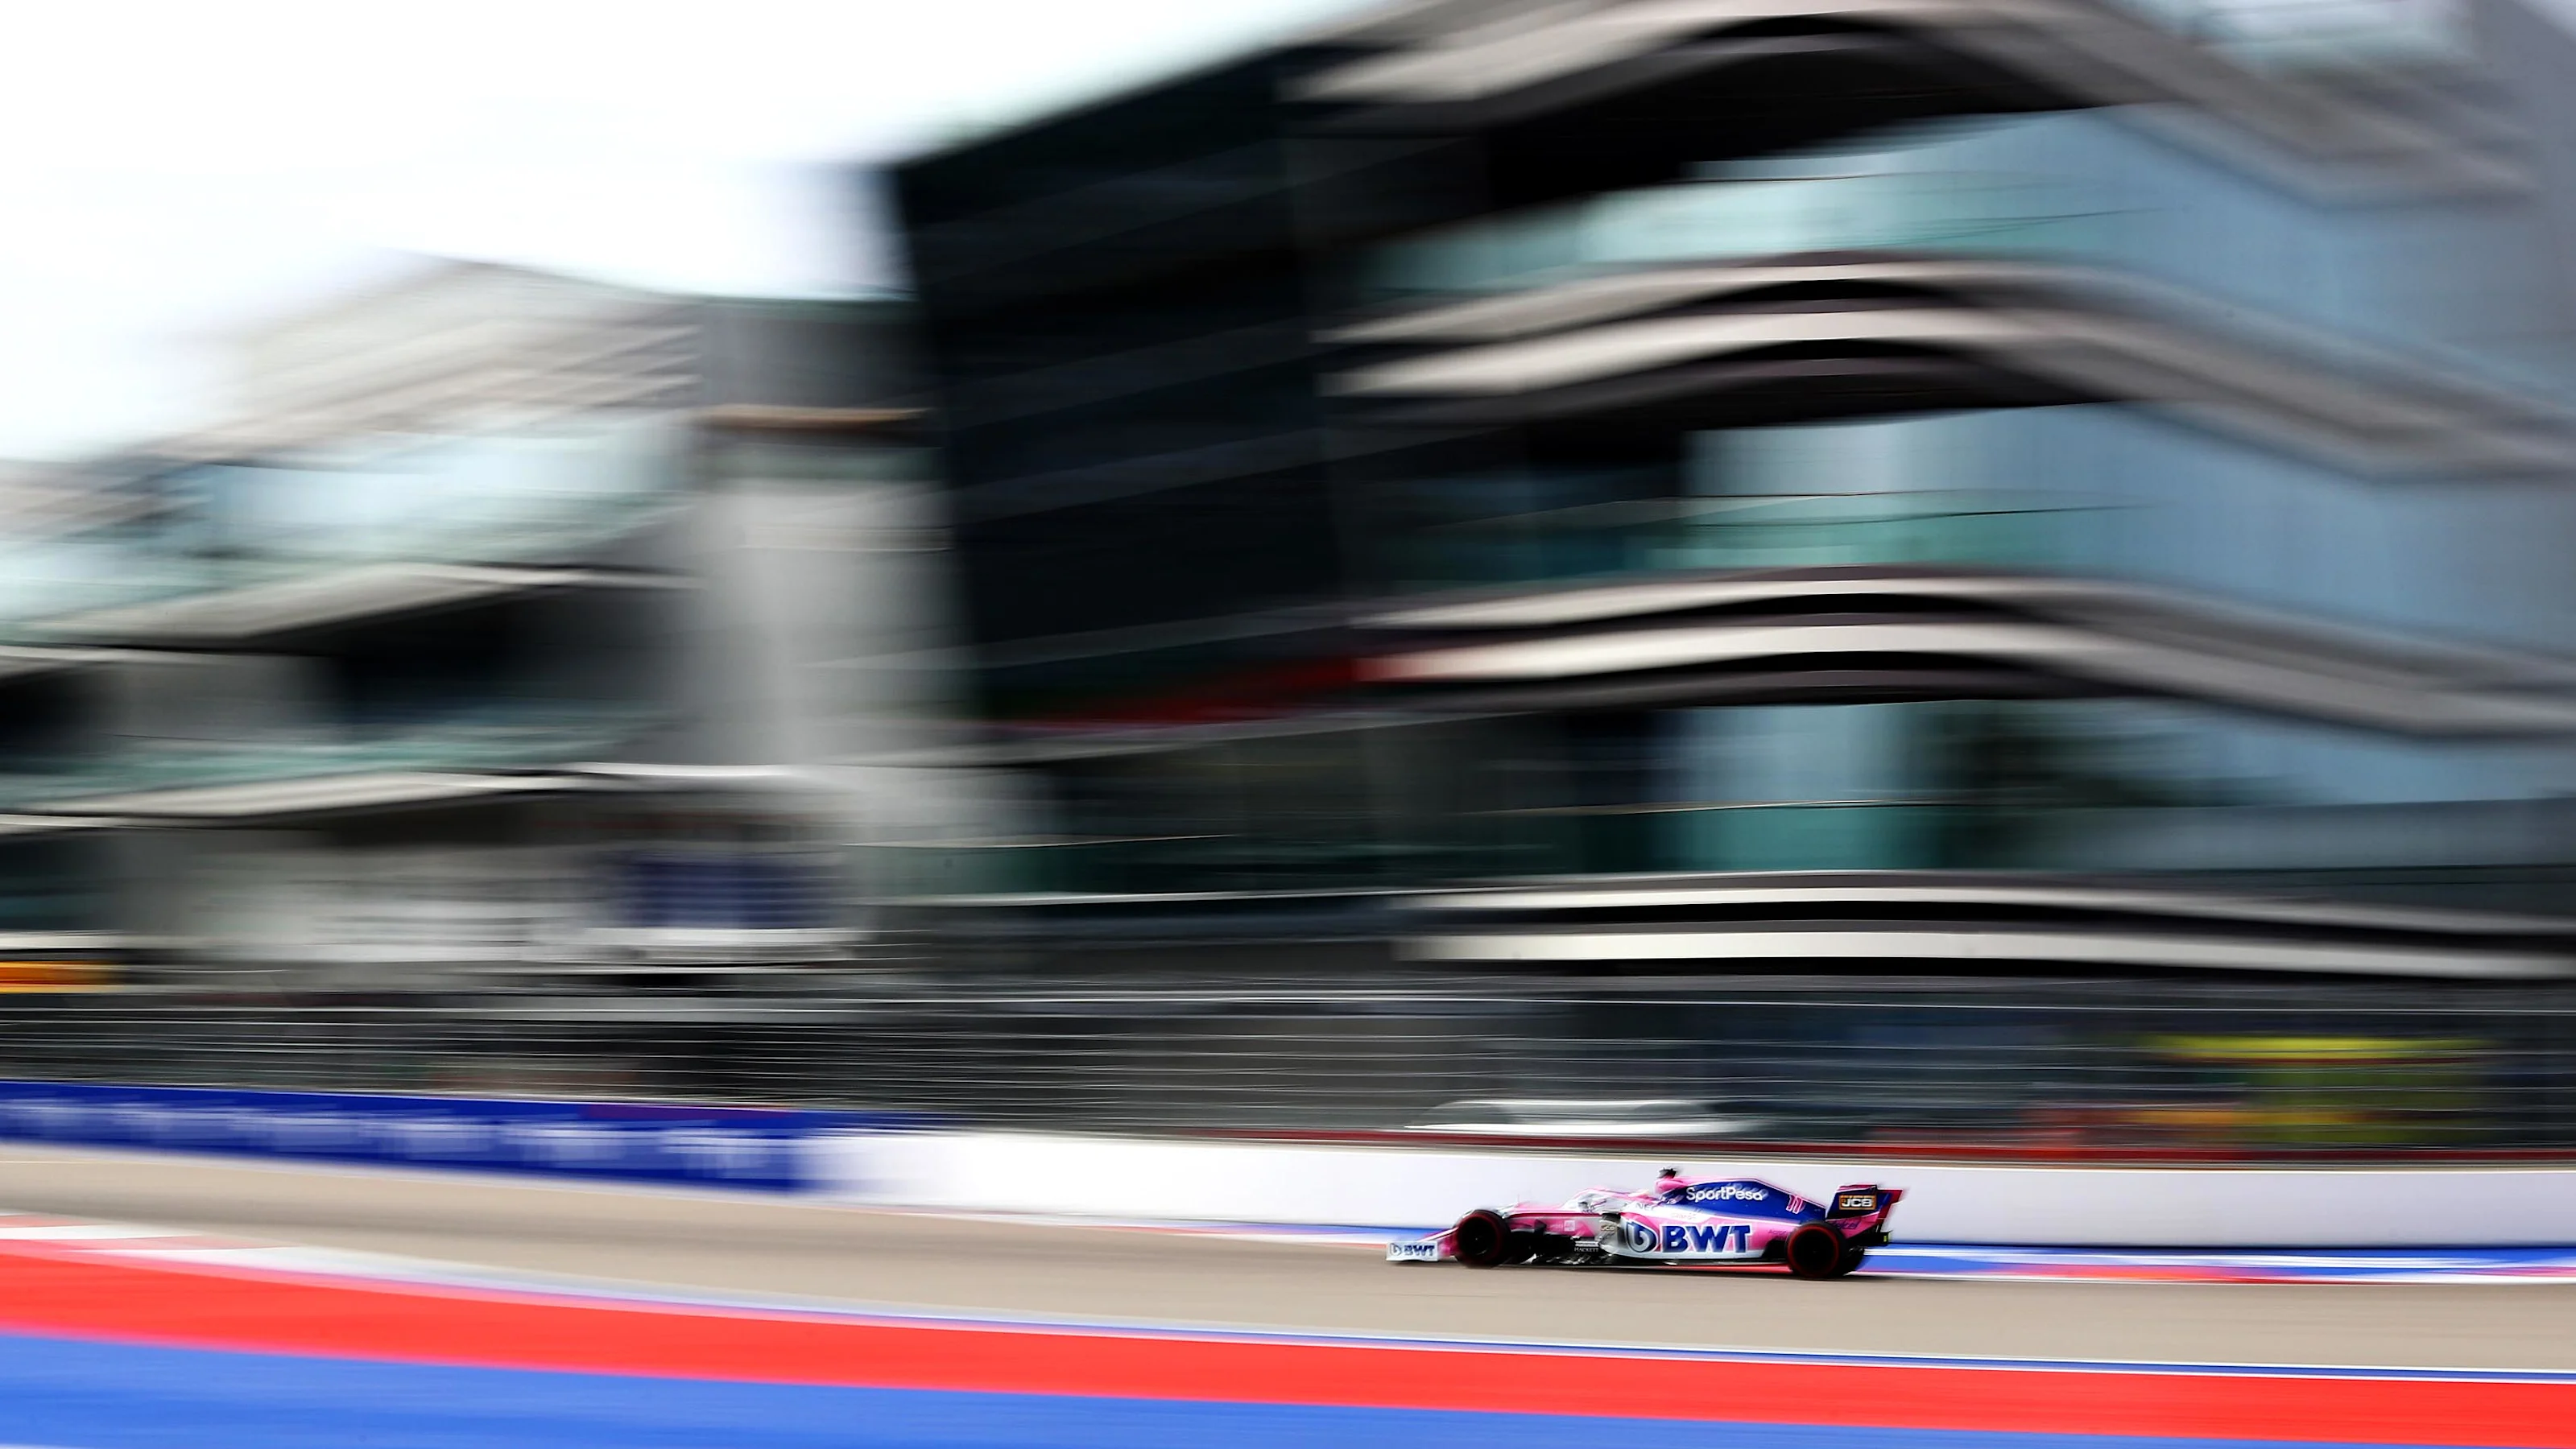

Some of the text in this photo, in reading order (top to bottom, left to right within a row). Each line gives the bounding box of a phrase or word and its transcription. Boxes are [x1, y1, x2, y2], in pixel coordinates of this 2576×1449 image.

[1686, 1186, 1764, 1203] SportPesa
[1841, 1198, 1873, 1208] JCB
[1661, 1224, 1751, 1253] BWT
[1404, 1245, 1435, 1257] BWT
